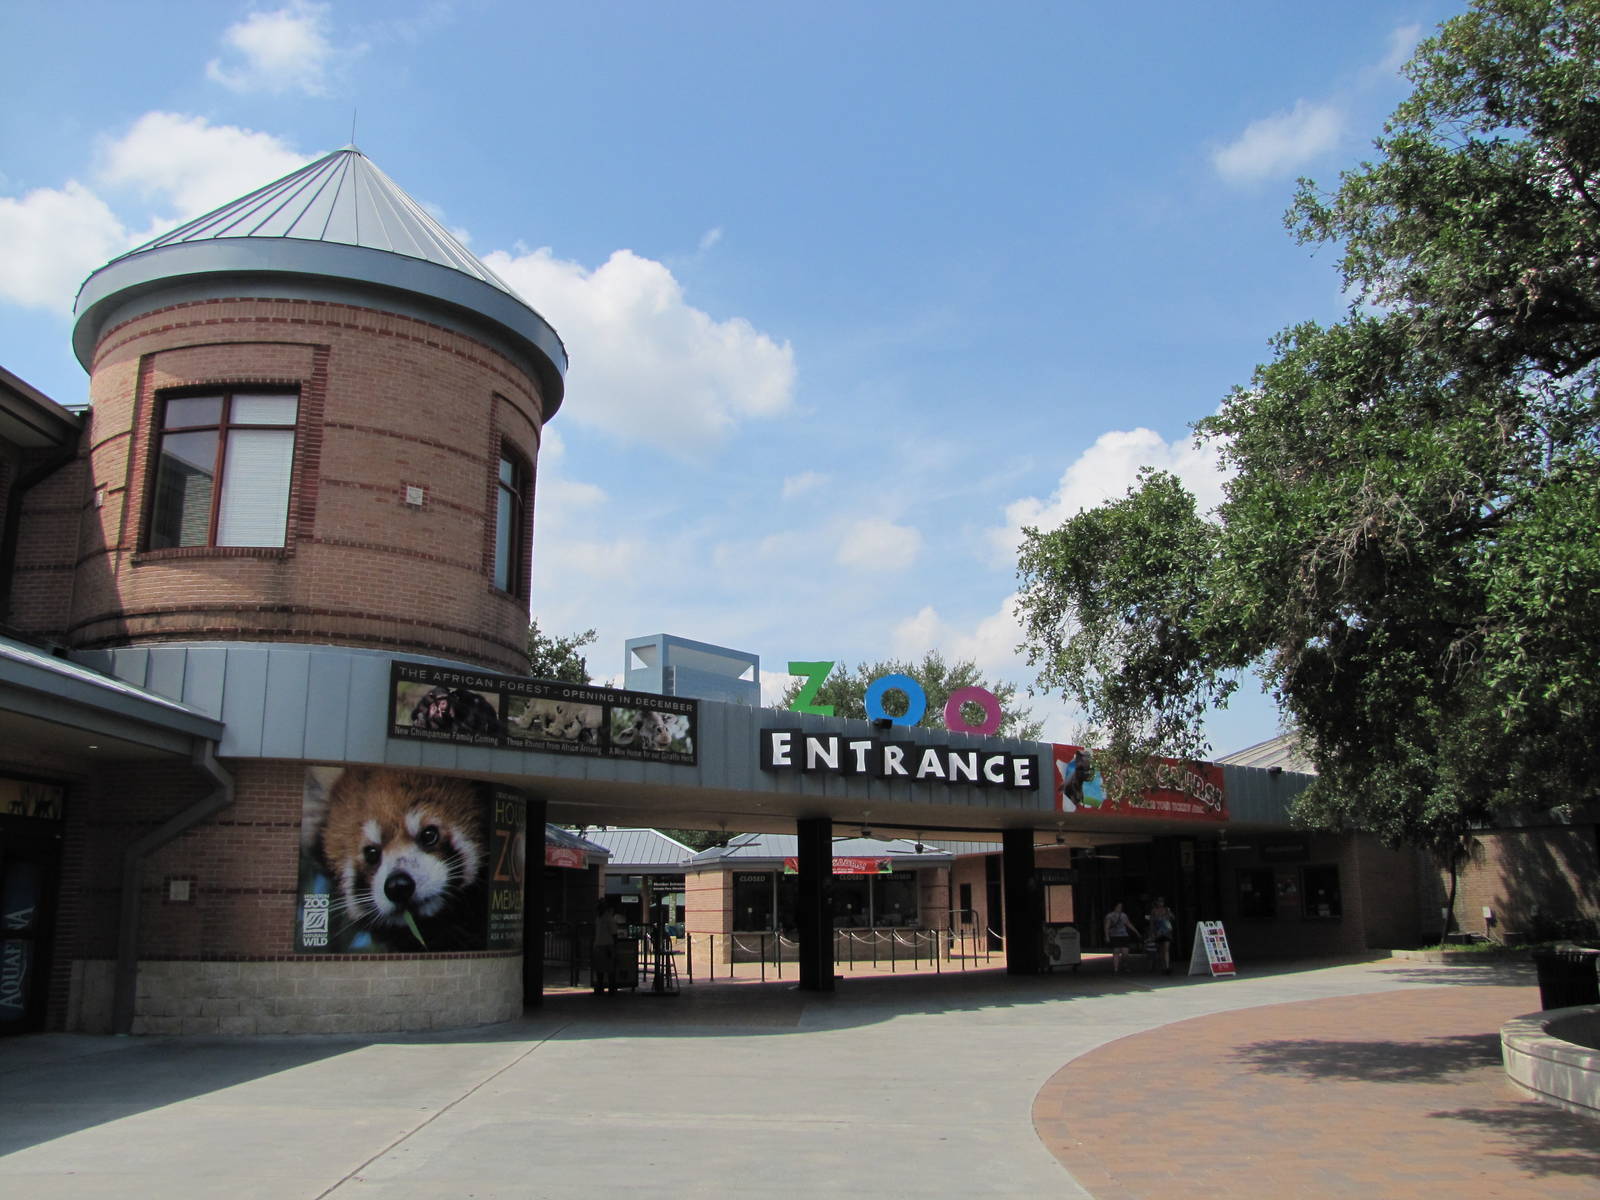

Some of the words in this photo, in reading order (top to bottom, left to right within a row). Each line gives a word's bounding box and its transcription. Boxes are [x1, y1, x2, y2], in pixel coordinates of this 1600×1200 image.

[399, 666, 427, 679] THE
[433, 672, 493, 688] AFRICAN
[500, 681, 550, 695] FOREST
[563, 689, 615, 703] OPENING
[619, 696, 631, 705] IN
[635, 698, 693, 712] DECEMBER
[788, 661, 1002, 737] ZOO
[395, 728, 409, 737] New
[452, 732, 473, 743] Family
[475, 735, 498, 746] Coming
[772, 733, 1030, 787] ENTRANCE
[304, 898, 330, 908] ZOO
[303, 937, 328, 947] WILD
